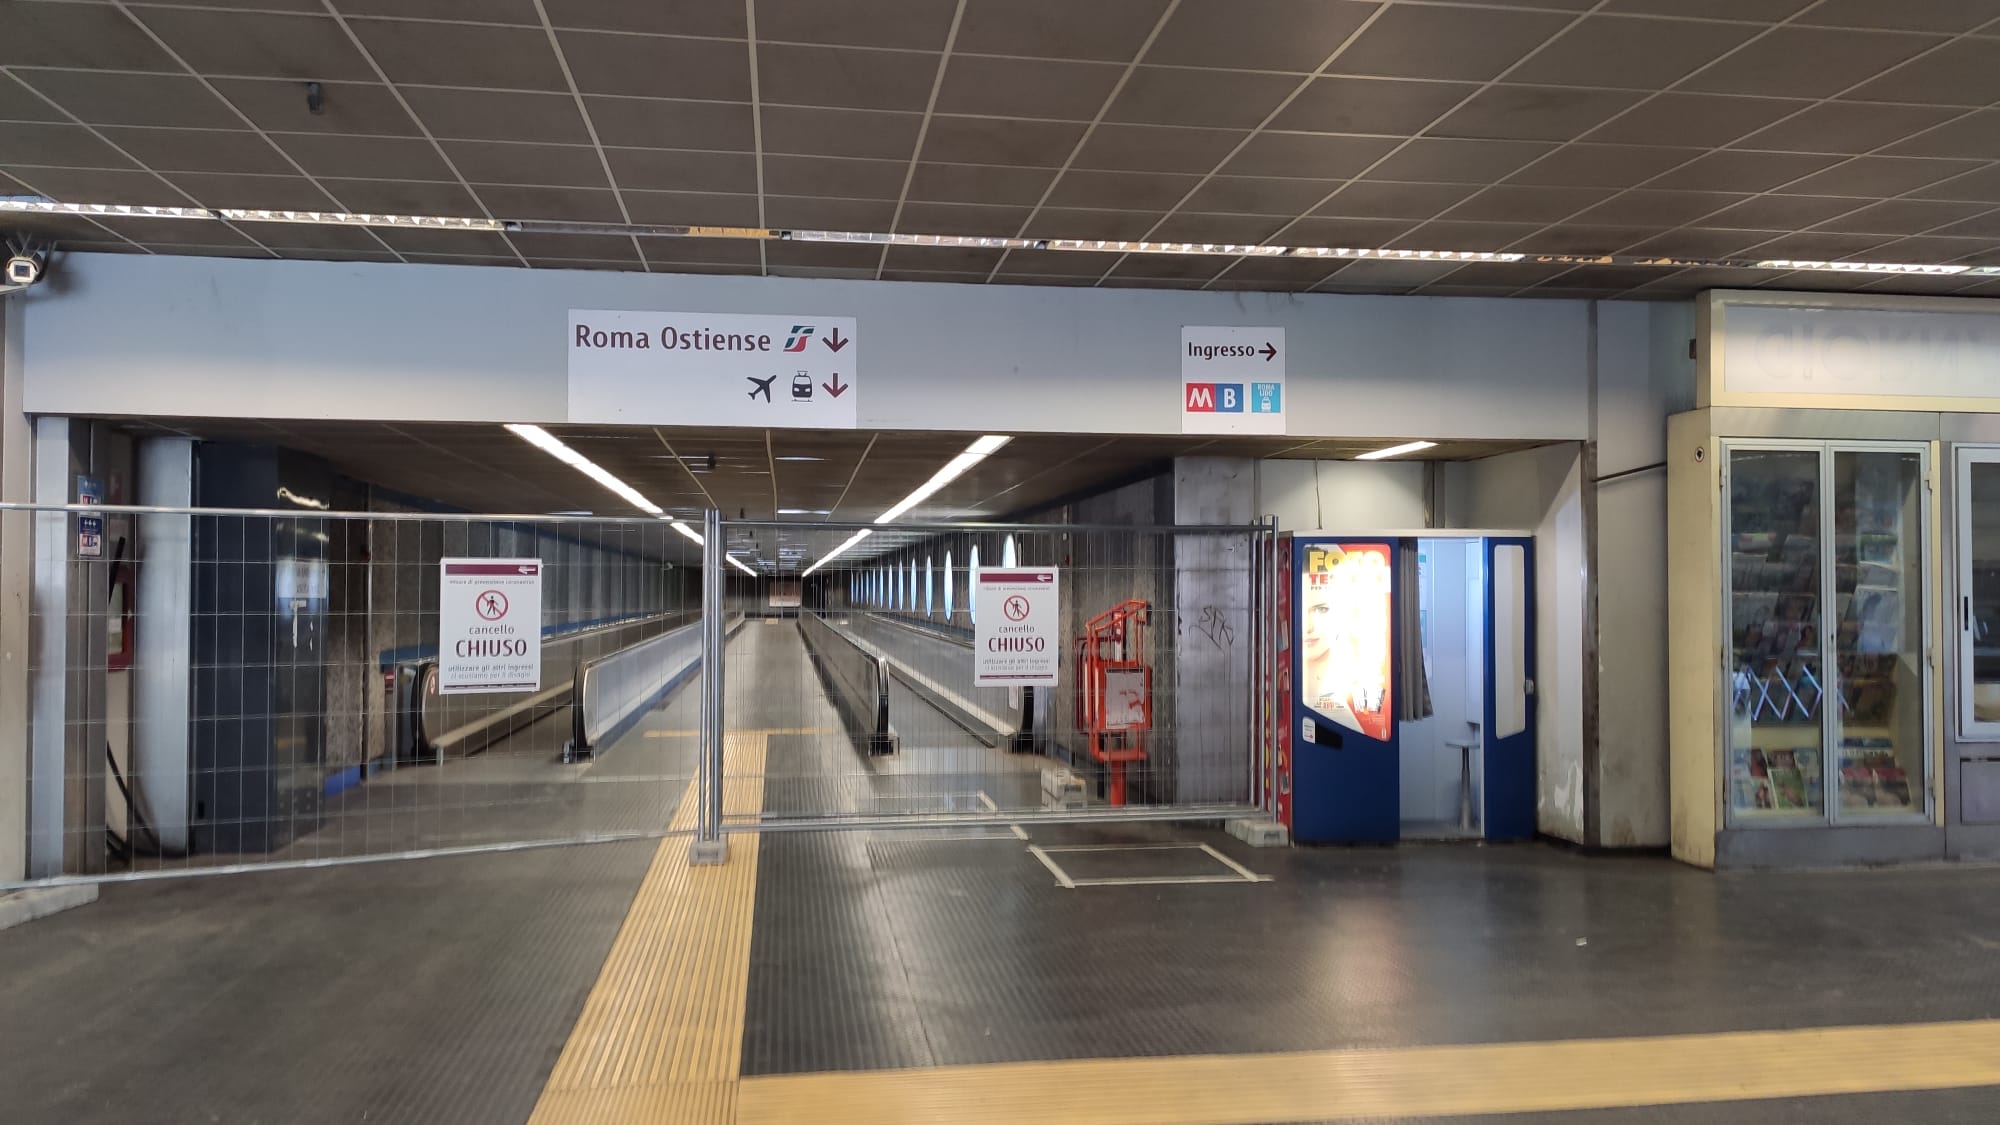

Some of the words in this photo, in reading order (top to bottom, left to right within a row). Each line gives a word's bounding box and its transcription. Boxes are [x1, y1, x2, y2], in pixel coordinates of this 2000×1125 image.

[575, 324, 650, 350] Roma
[661, 326, 771, 352] Ostiense
[1188, 341, 1255, 361] Ingresso
[1257, 383, 1275, 391] ROMA
[1188, 387, 1213, 408] M
[1223, 388, 1236, 408] B
[469, 624, 515, 635] cancello
[998, 624, 1035, 634] cancello
[455, 639, 527, 658] CHIUSO
[988, 637, 1045, 653] CHIUSO
